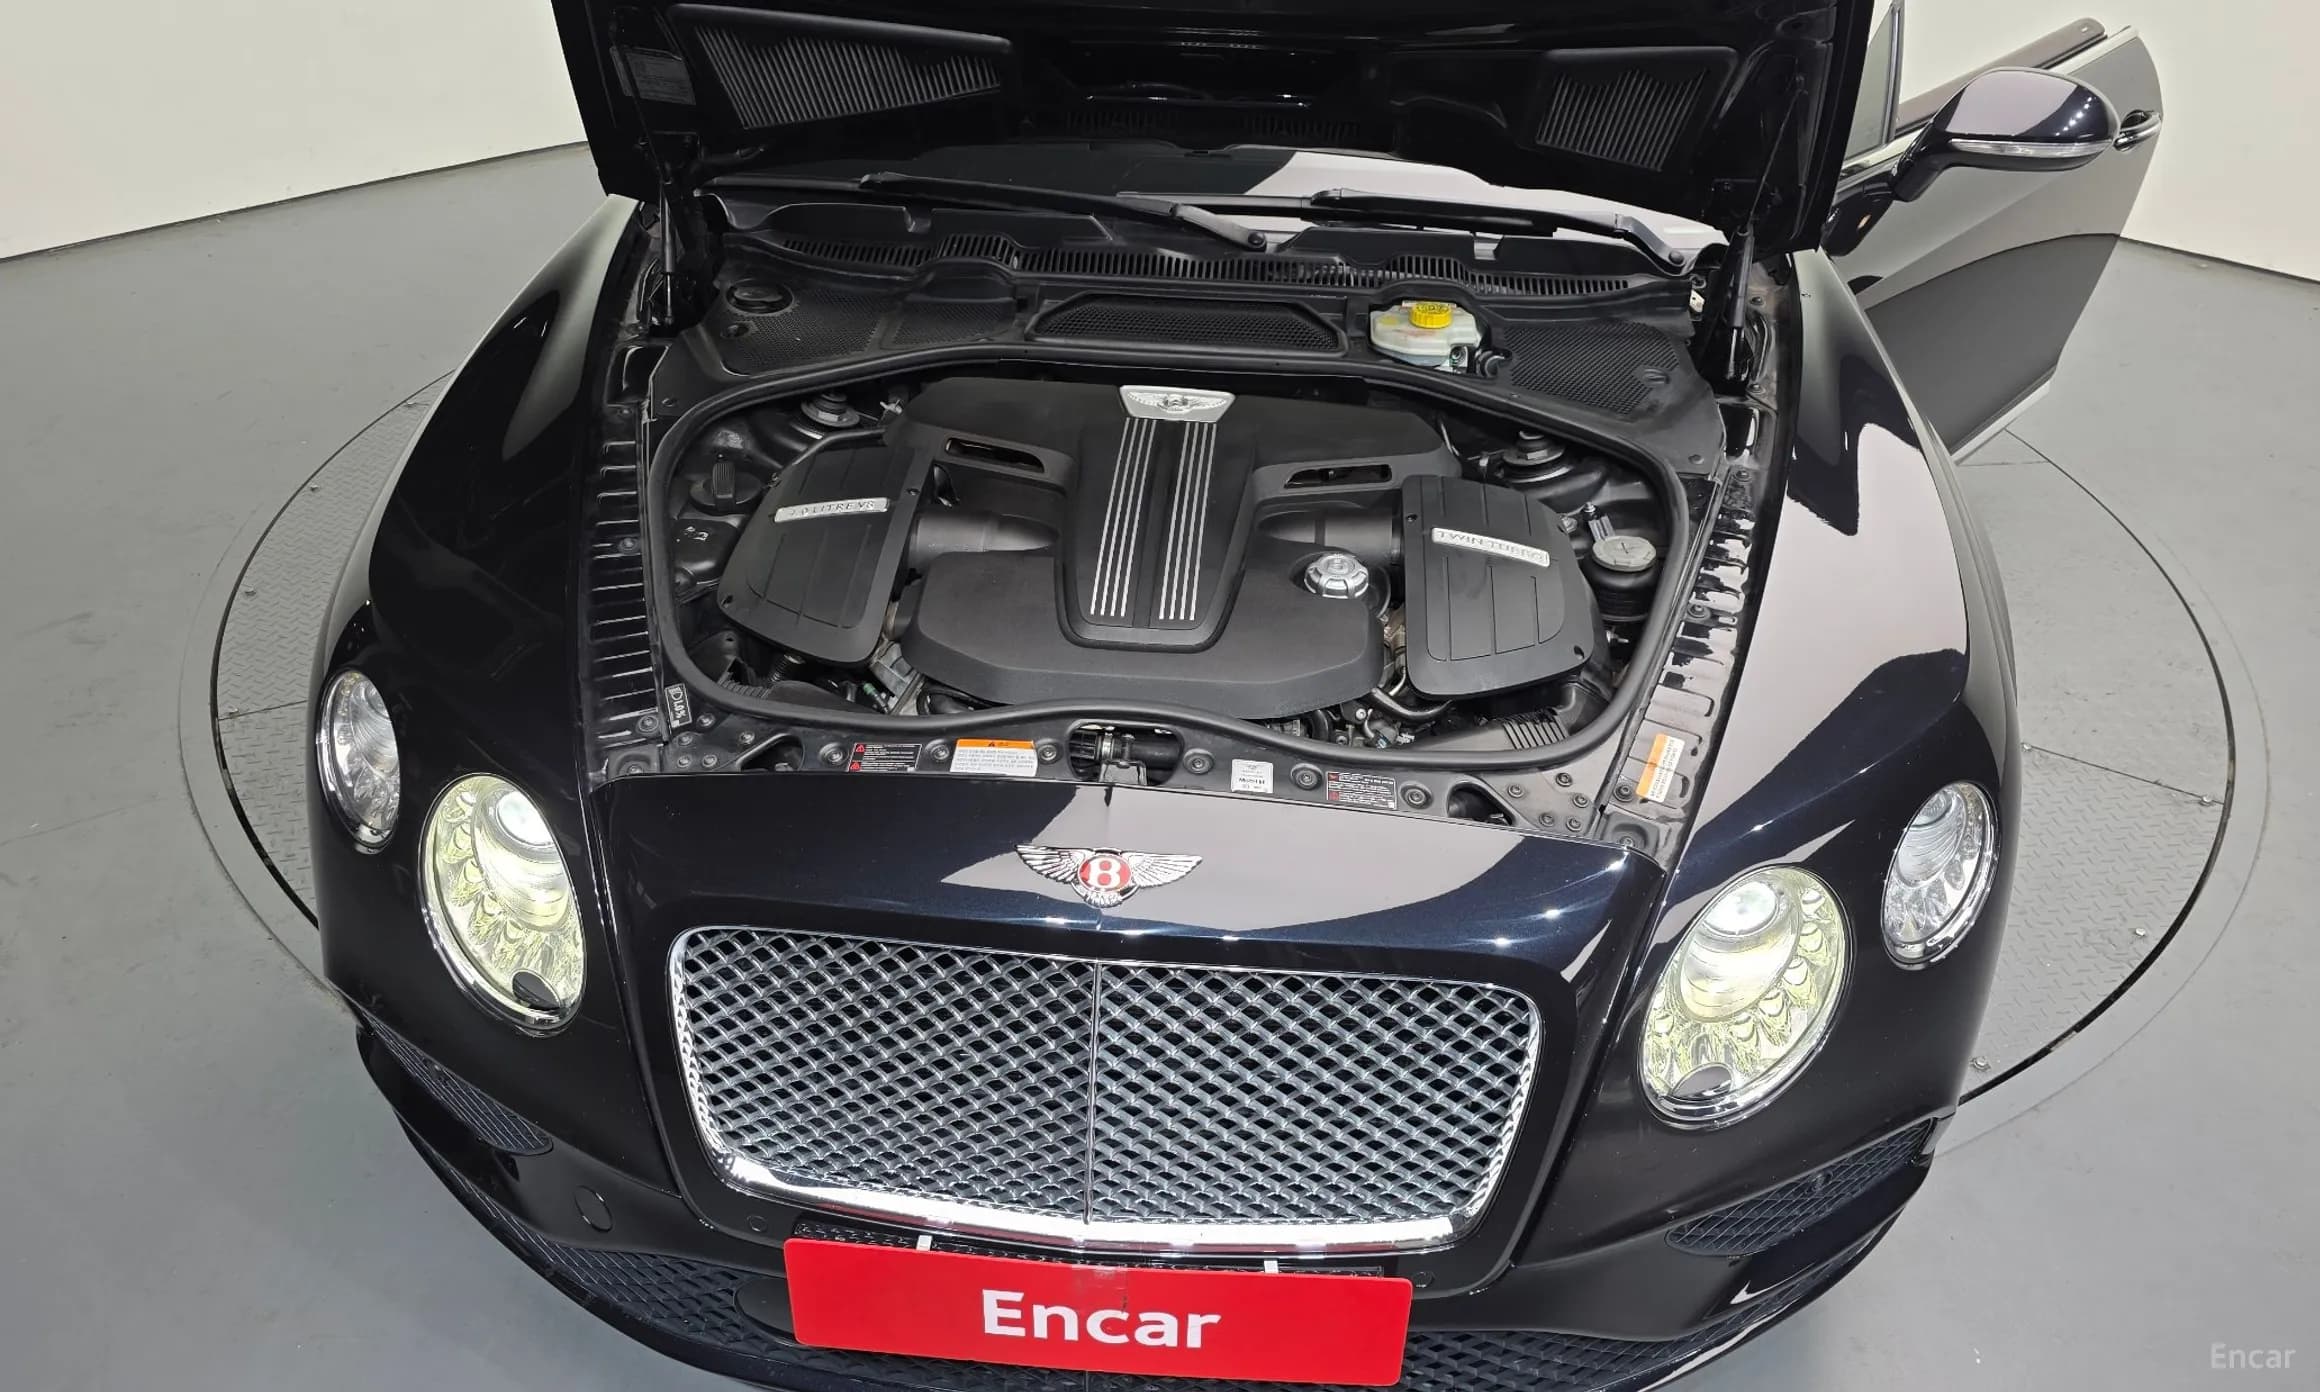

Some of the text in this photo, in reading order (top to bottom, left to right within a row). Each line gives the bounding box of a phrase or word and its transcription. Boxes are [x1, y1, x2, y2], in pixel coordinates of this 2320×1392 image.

[812, 503, 854, 514] LITRE
[1437, 530, 1545, 562] TWIN TURBO
[1089, 857, 1121, 889] B
[982, 1288, 1222, 1349] Encar
